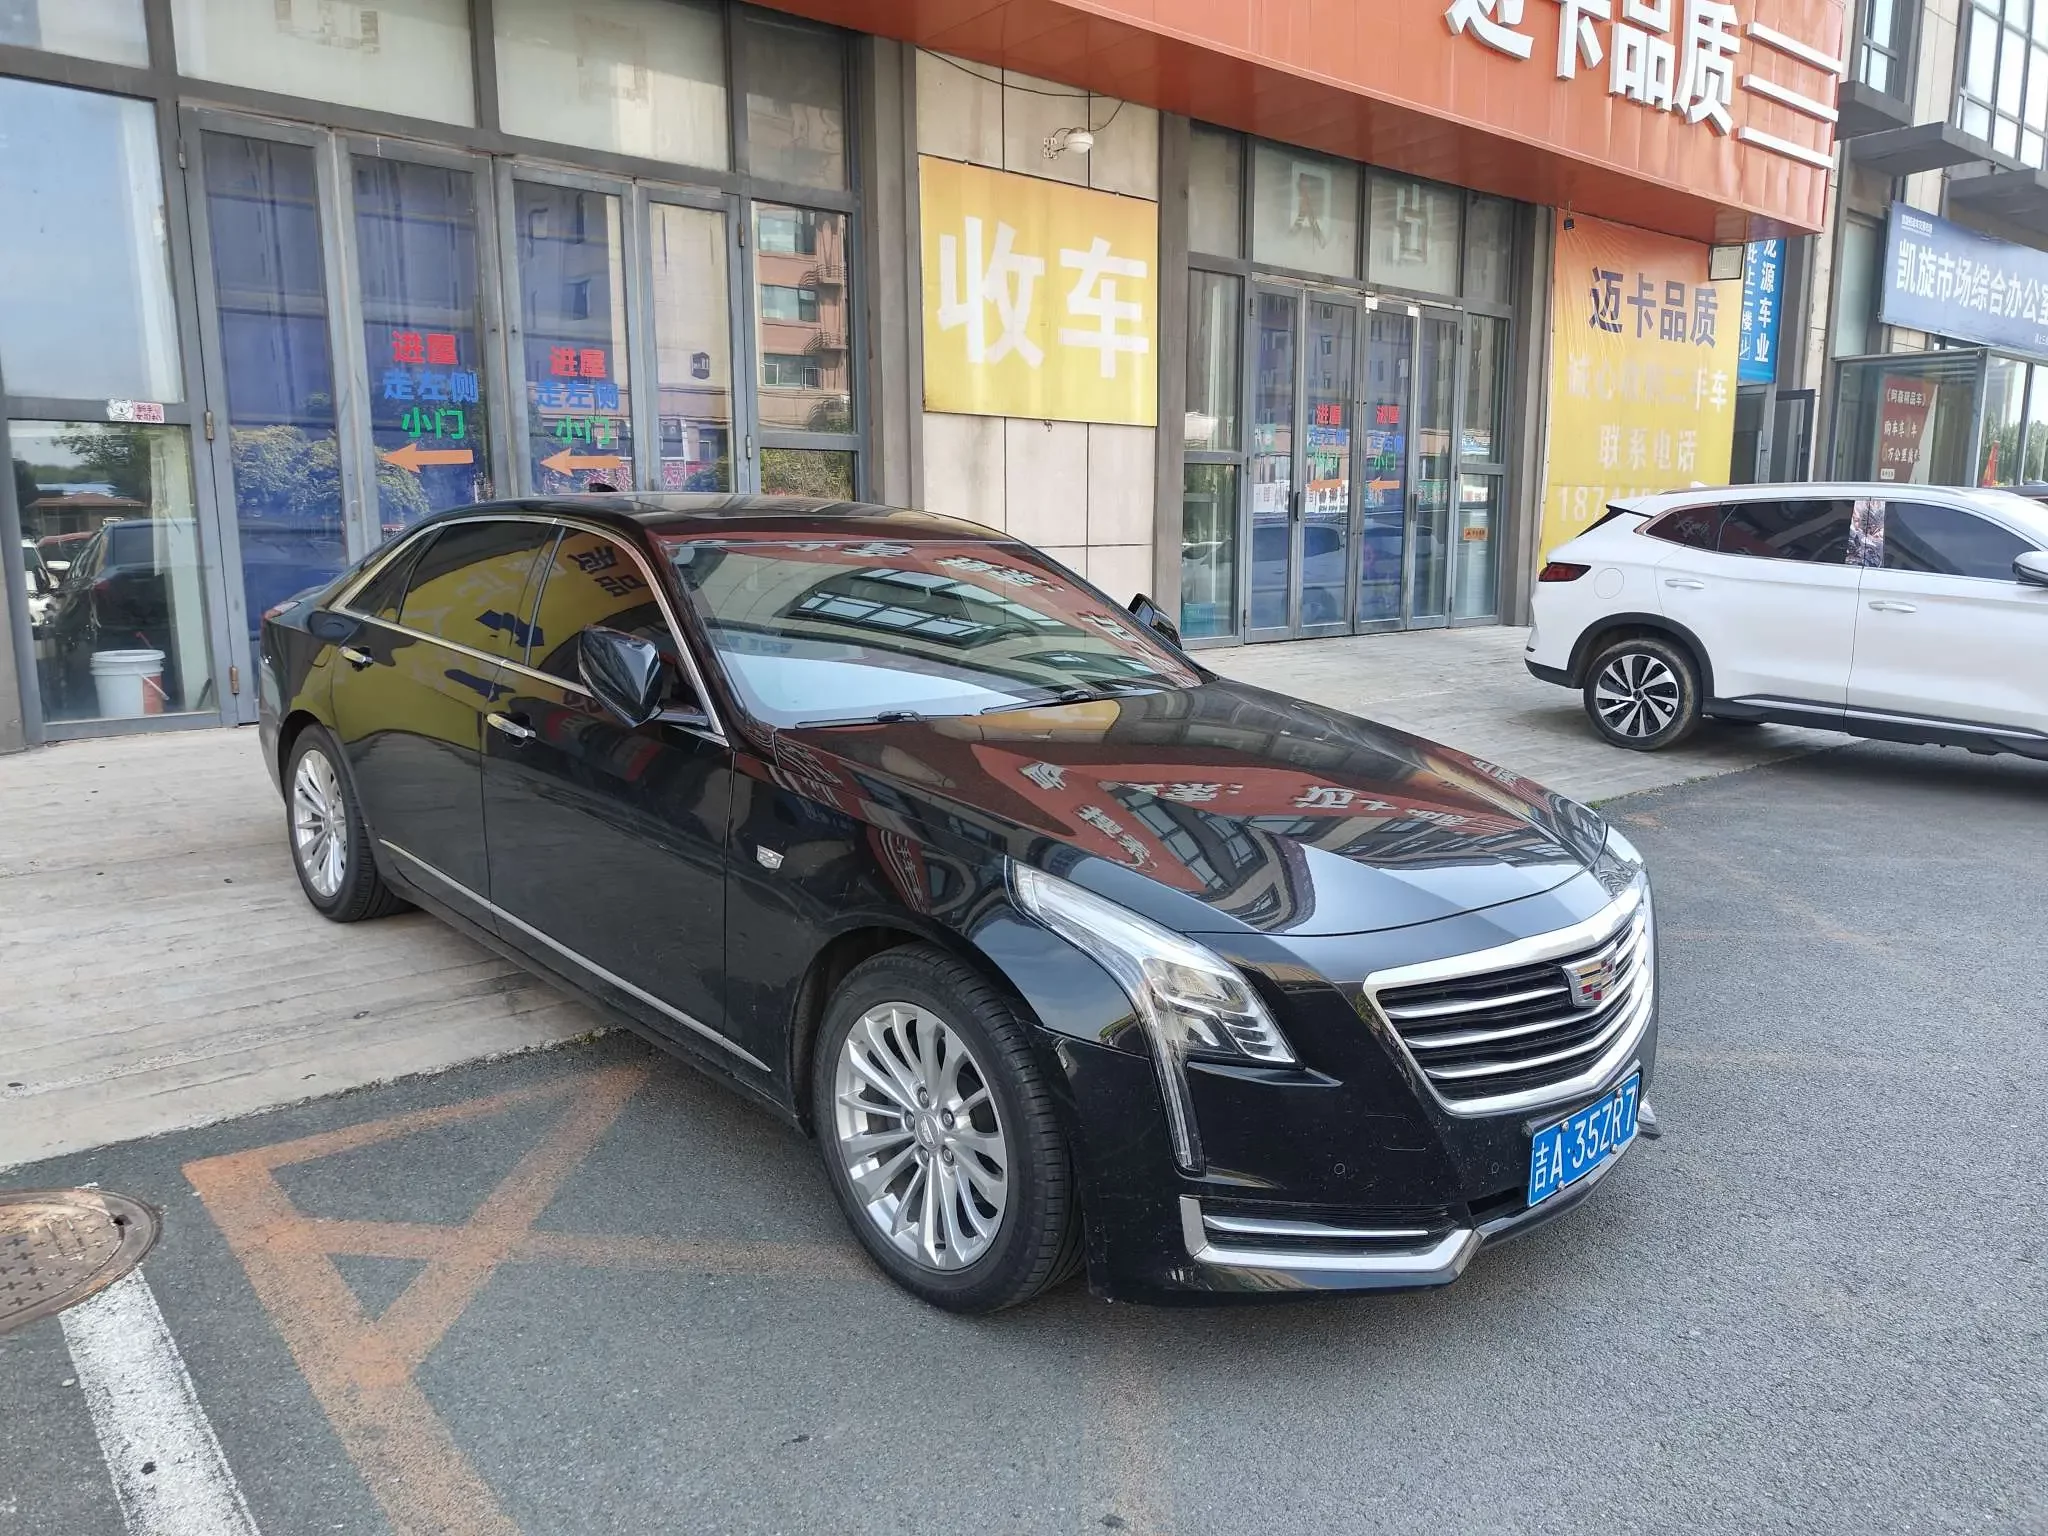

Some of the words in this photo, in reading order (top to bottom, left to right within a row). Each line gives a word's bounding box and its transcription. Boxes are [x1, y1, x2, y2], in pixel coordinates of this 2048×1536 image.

[937, 216, 1149, 379] 收车
[1588, 266, 1719, 349] 迈卡品质
[392, 331, 459, 366] 进屋
[549, 346, 609, 379] 进屋
[383, 369, 479, 404] 走左侧
[536, 380, 620, 412] 走左侧
[401, 407, 465, 440] 小门
[556, 415, 613, 446] 小门
[1599, 425, 1698, 473] 联系电话
